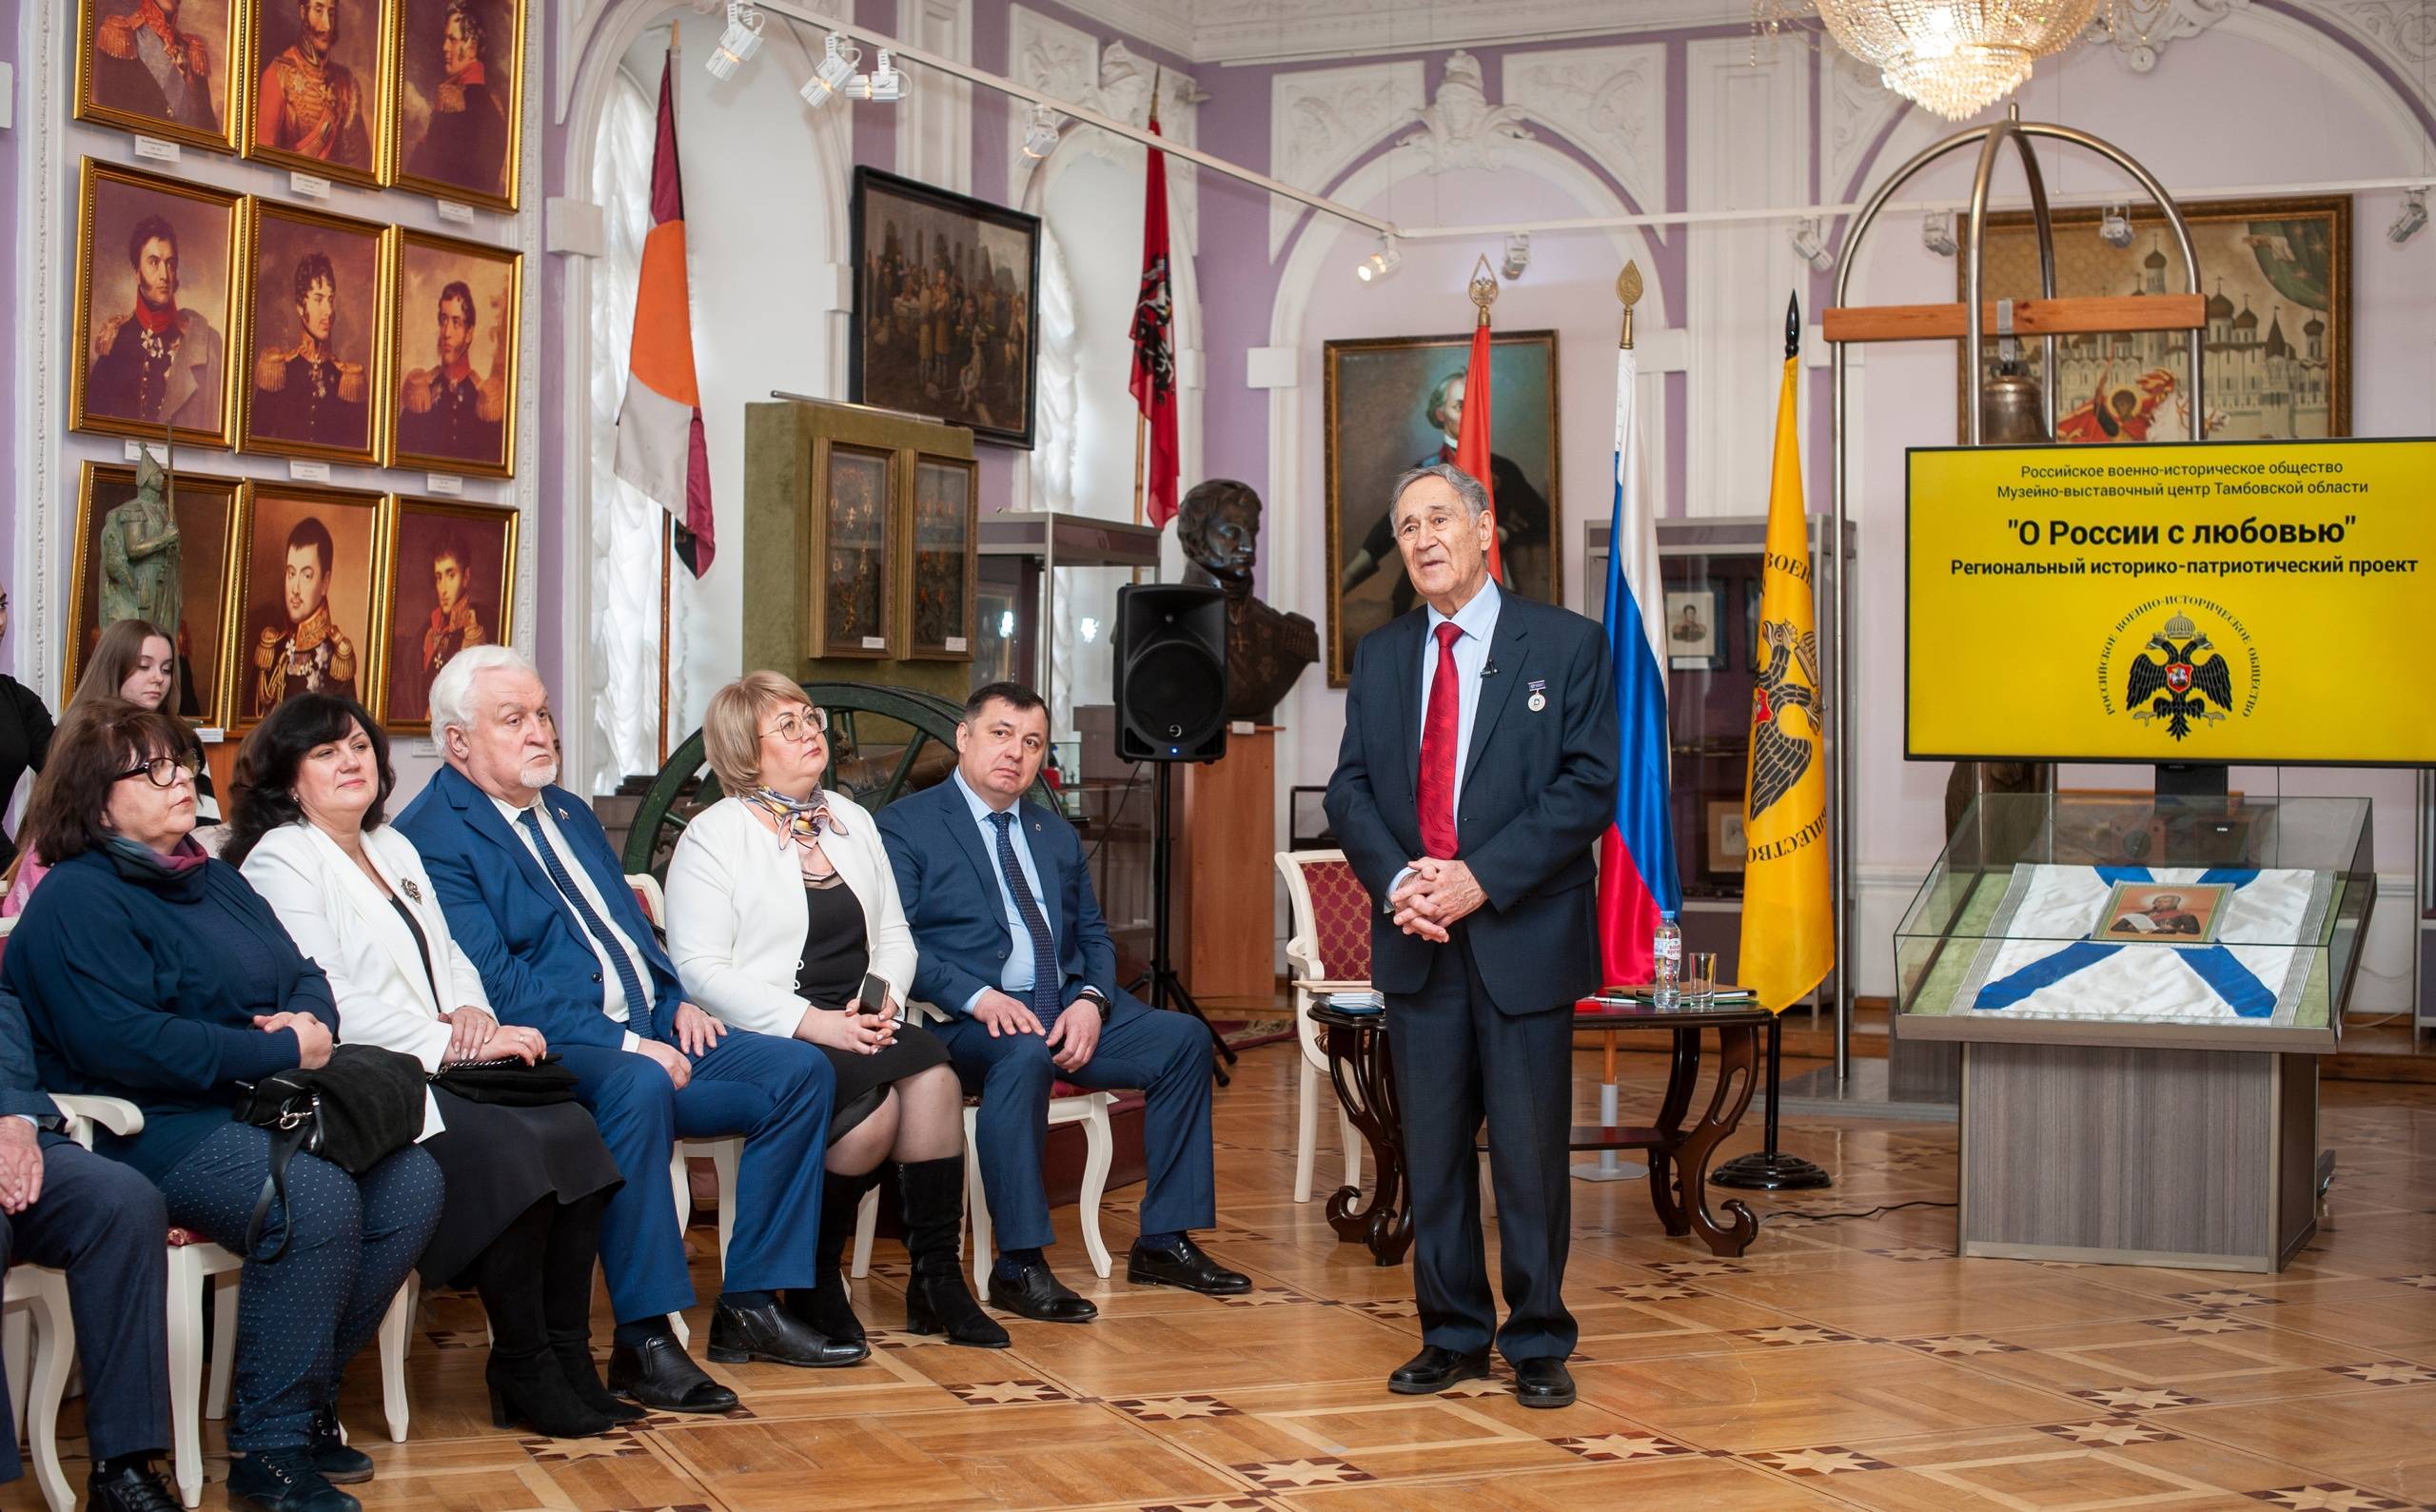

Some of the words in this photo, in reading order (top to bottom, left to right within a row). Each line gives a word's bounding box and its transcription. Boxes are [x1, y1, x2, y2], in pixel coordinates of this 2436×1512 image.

[2021, 463, 2105, 479] Российское
[2108, 462, 2266, 479] военно-историческое
[2269, 461, 2344, 477] общество
[1997, 482, 2164, 501] Музейно-выставочный
[2168, 485, 2210, 500] центр
[2214, 481, 2304, 496] Тамбовской
[2307, 481, 2368, 495] области
[2008, 519, 2040, 546] "О
[2050, 520, 2159, 545] России
[2168, 525, 2185, 544] с
[2191, 515, 2356, 544] любовью"
[1951, 558, 2086, 576] Региональный
[2091, 555, 2344, 578] историко-патриотический
[2348, 559, 2419, 577] проект
[2097, 633, 2118, 716] РОССИЙСКОЕ
[2115, 595, 2252, 645] ВОЕННО-ИСТОРИЧЕСКОЕ
[2242, 647, 2261, 717] ОБЩЕСТВО
